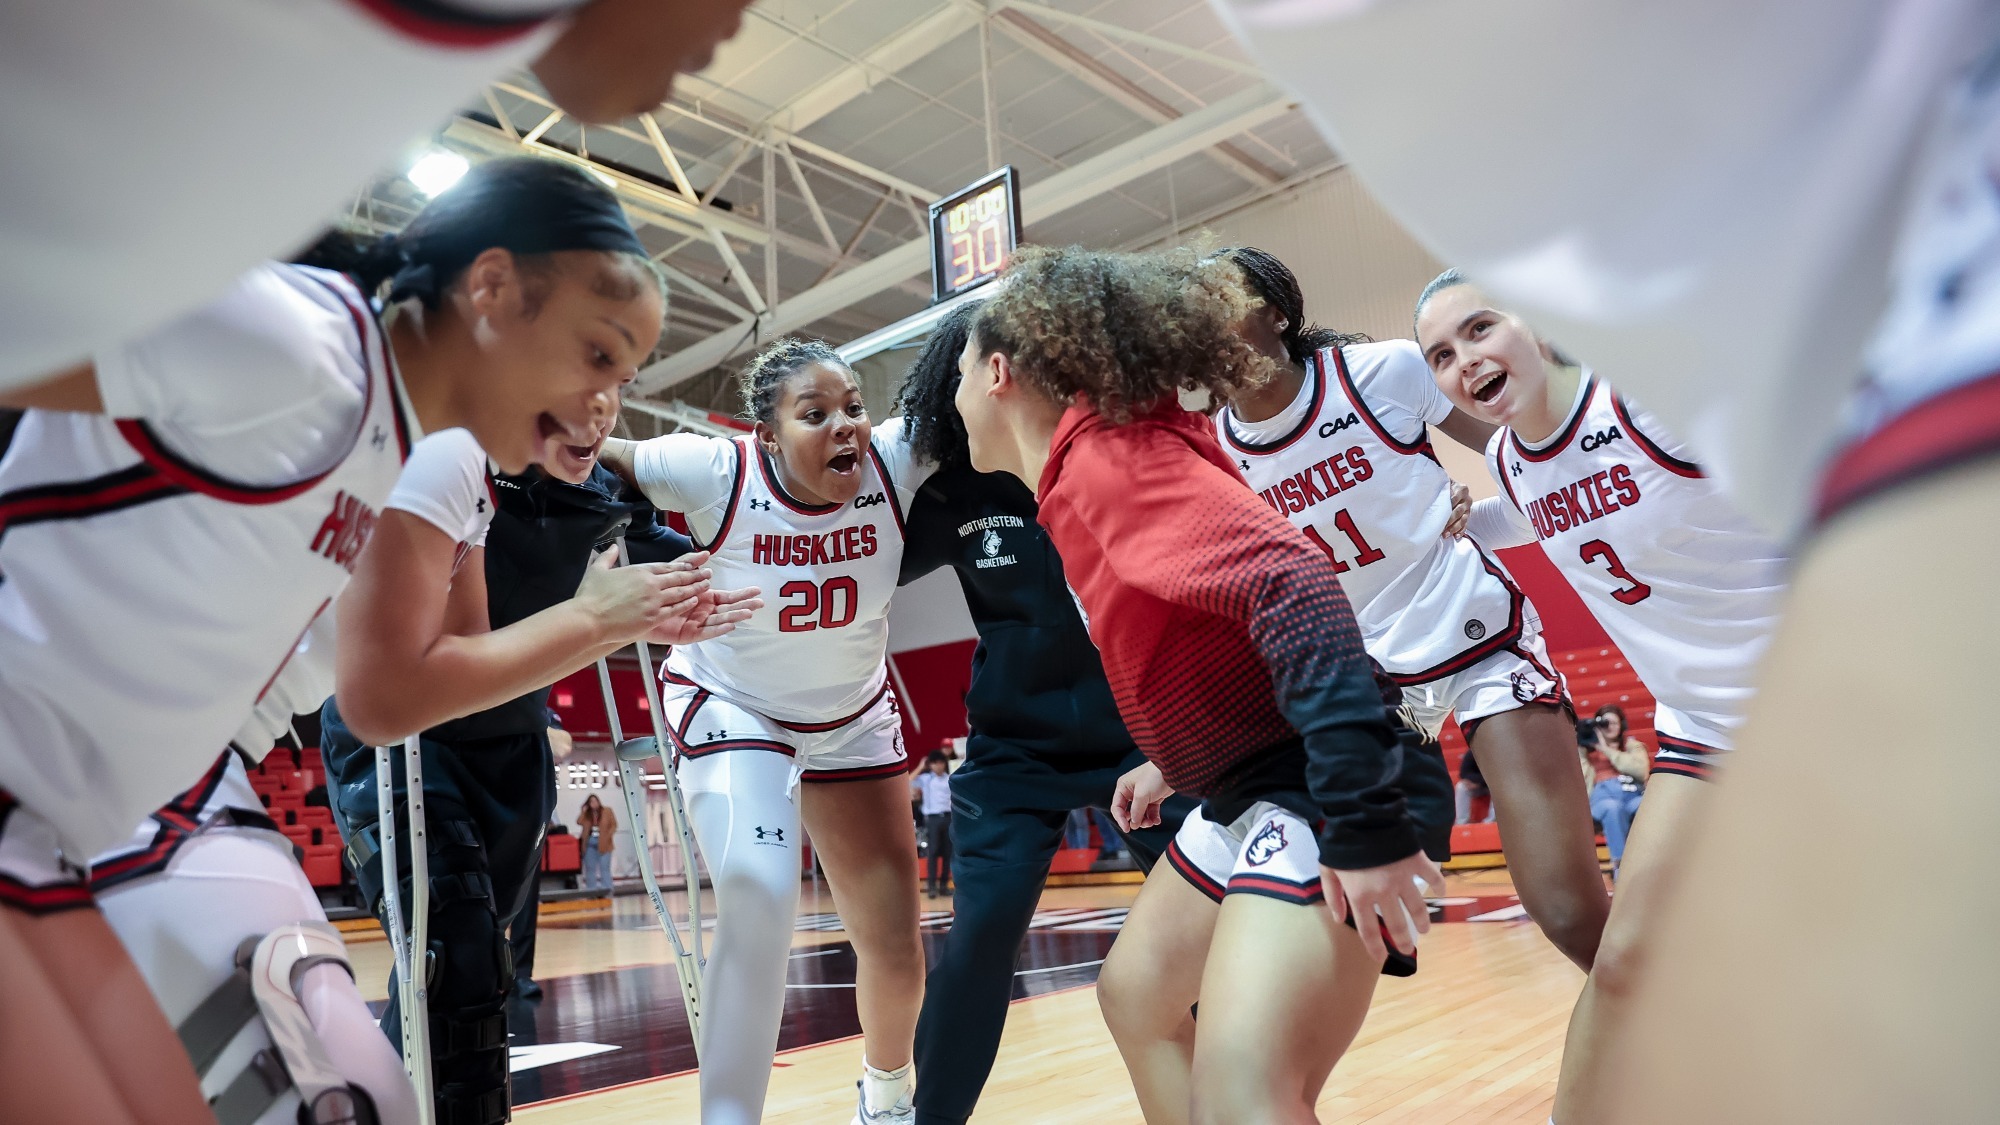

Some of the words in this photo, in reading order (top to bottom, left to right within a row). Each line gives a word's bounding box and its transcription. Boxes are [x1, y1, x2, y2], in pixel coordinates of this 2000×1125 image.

[952, 219, 1003, 286] 30
[1318, 412, 1360, 439] CAA
[1580, 425, 1623, 452] CAA
[854, 491, 887, 509] CAA
[1257, 445, 1374, 518] USKIES
[1525, 463, 1641, 541] HUSKIES
[752, 523, 878, 567] HUSKIES
[957, 515, 1025, 538] NORTHEASTERN
[975, 554, 1018, 569] BASKETBALL
[1579, 538, 1651, 605] 3
[779, 575, 858, 632] 20
